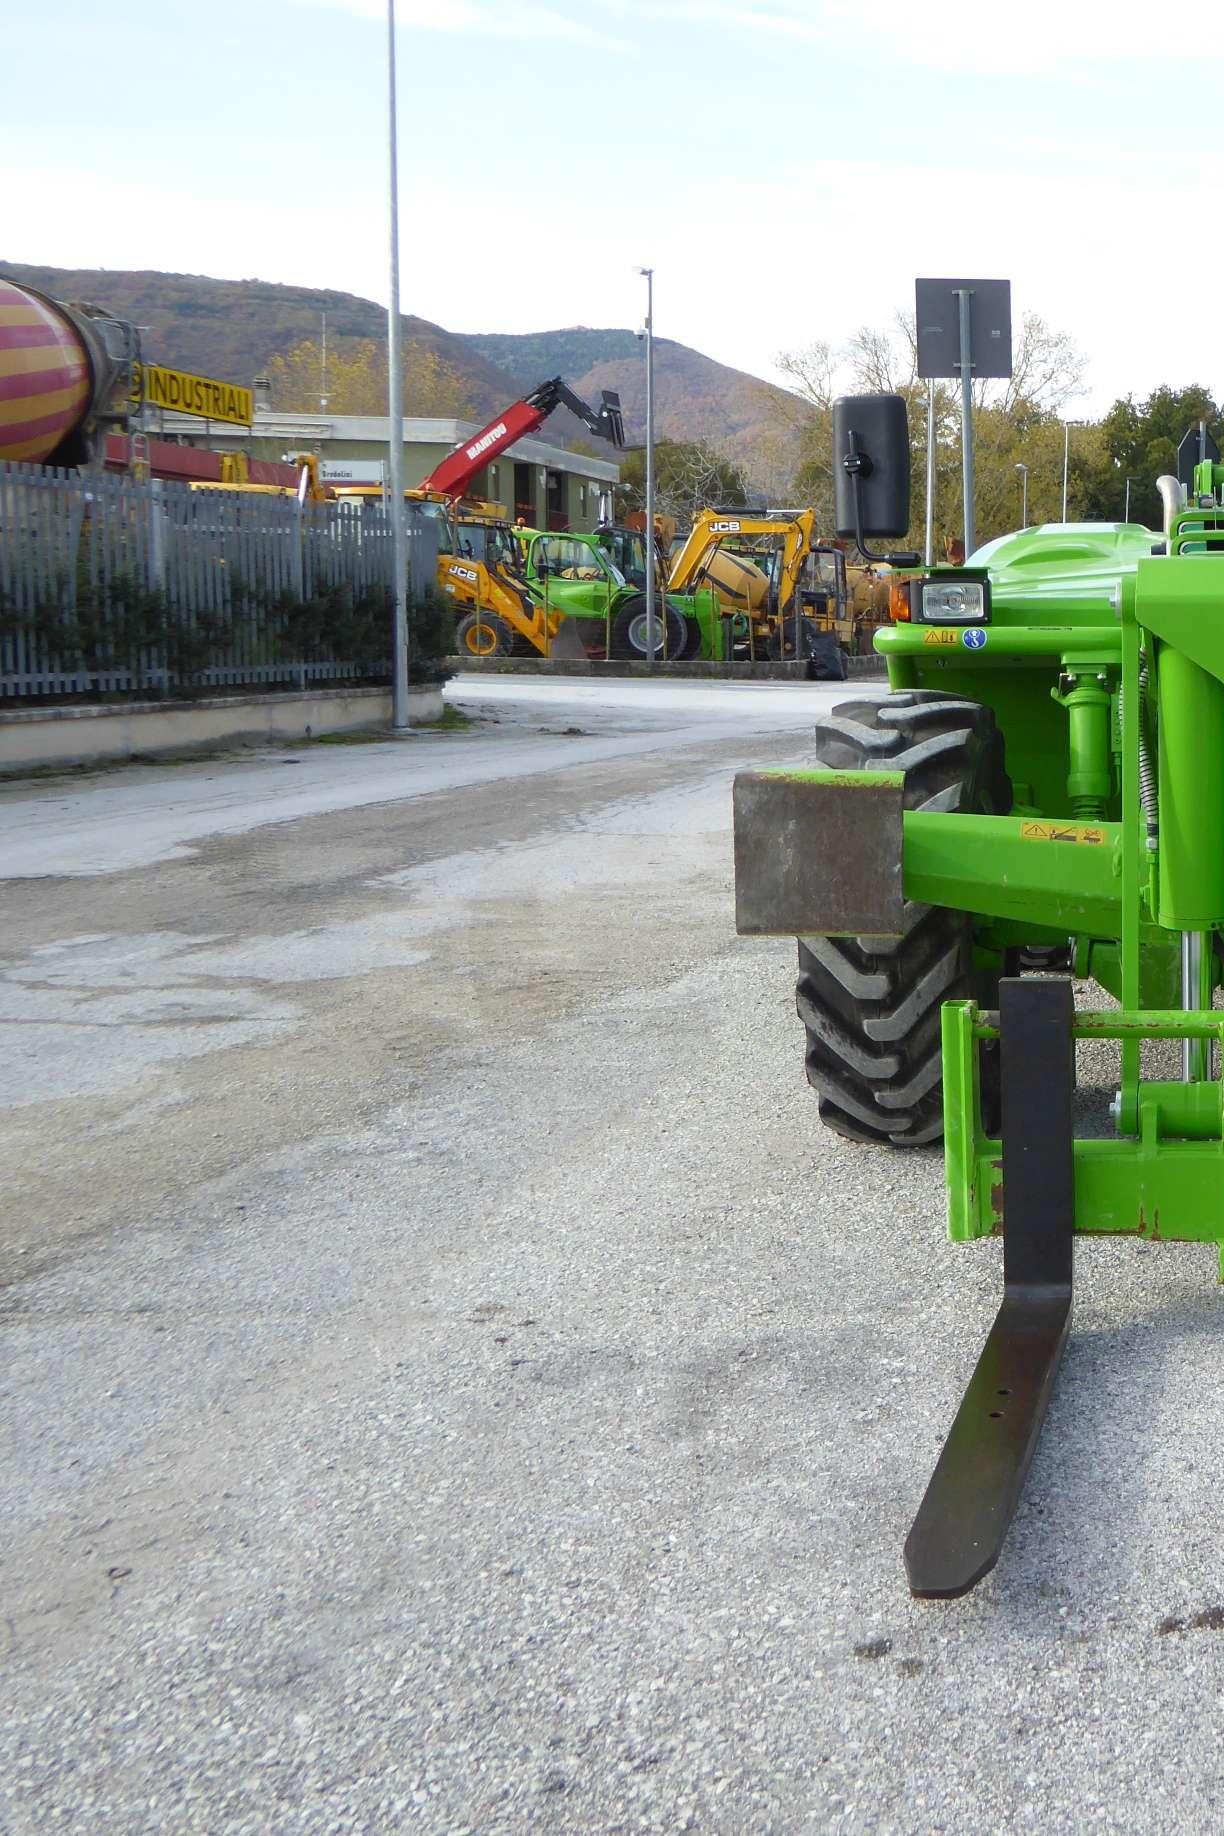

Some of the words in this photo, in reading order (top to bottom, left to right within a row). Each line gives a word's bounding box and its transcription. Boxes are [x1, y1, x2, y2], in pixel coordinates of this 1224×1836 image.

[147, 368, 249, 420] INDUSTRIALI
[466, 422, 507, 460] MANITOU
[709, 521, 741, 532] JCB
[449, 565, 478, 580] JCB
